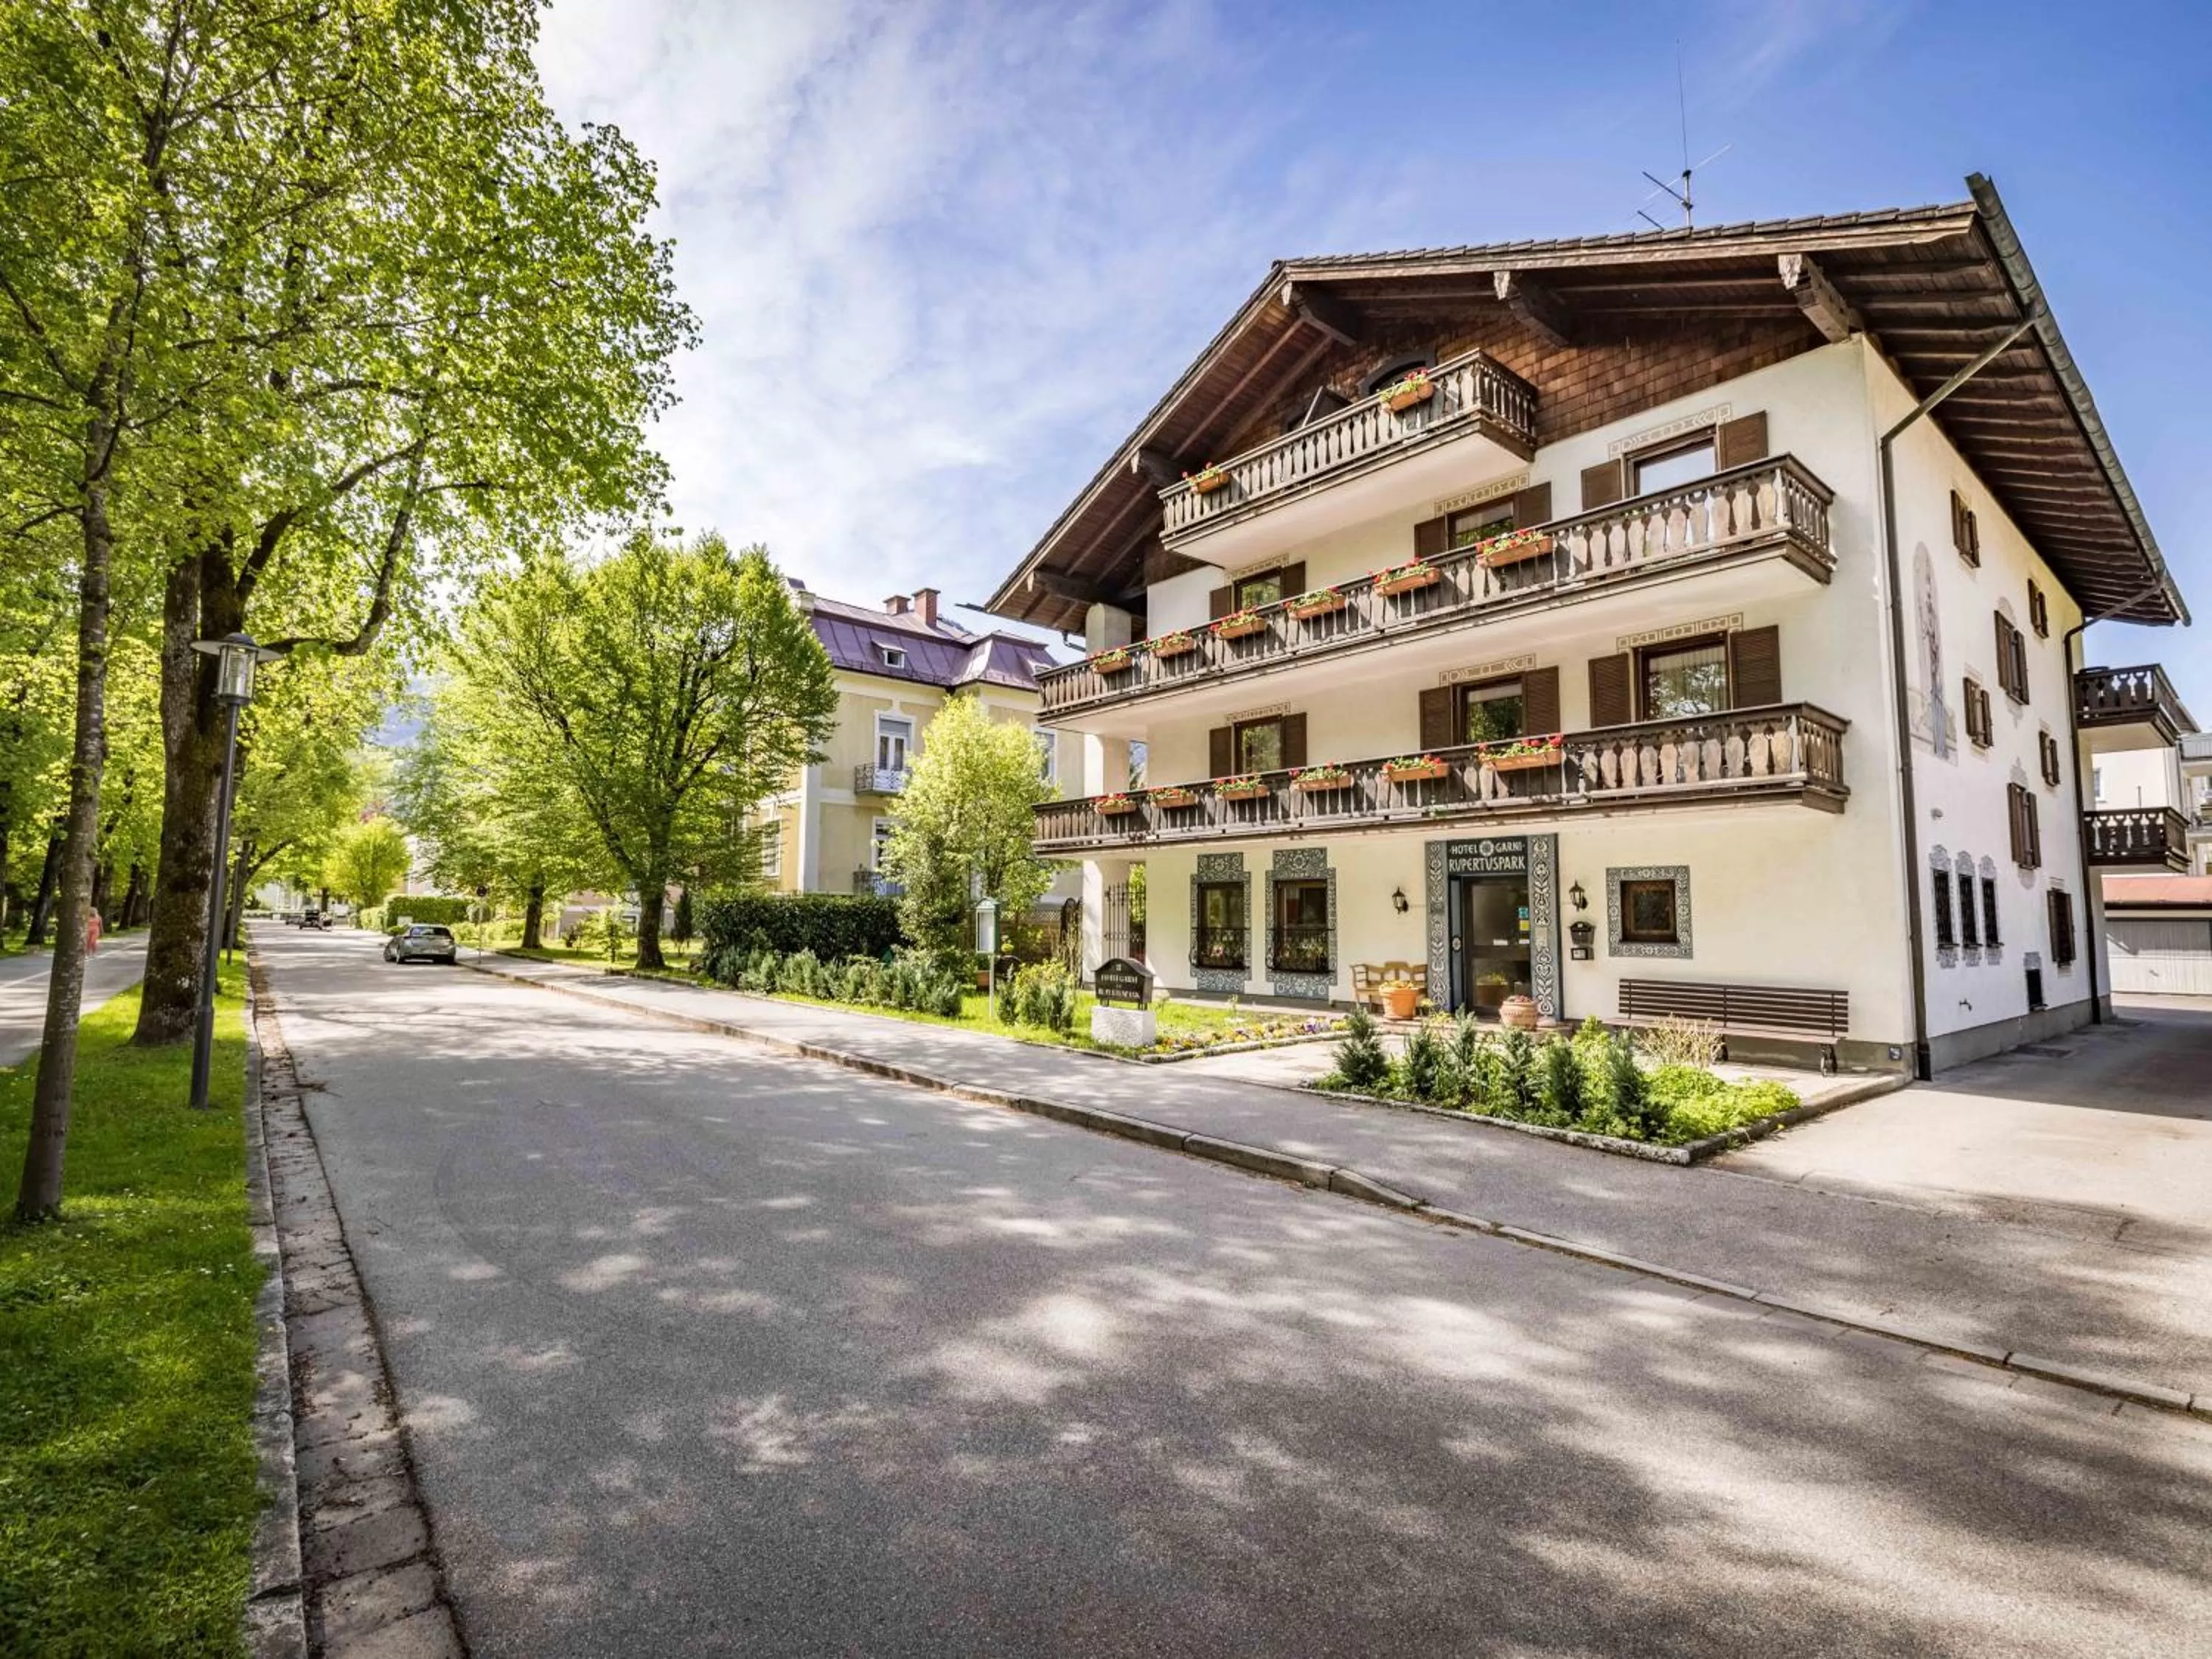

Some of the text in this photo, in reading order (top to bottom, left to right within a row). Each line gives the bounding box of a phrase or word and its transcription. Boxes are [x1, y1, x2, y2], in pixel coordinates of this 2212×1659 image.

[1451, 841, 1523, 855] HOTEL GARNI
[1449, 855, 1526, 872] RUPERTUSPARK
